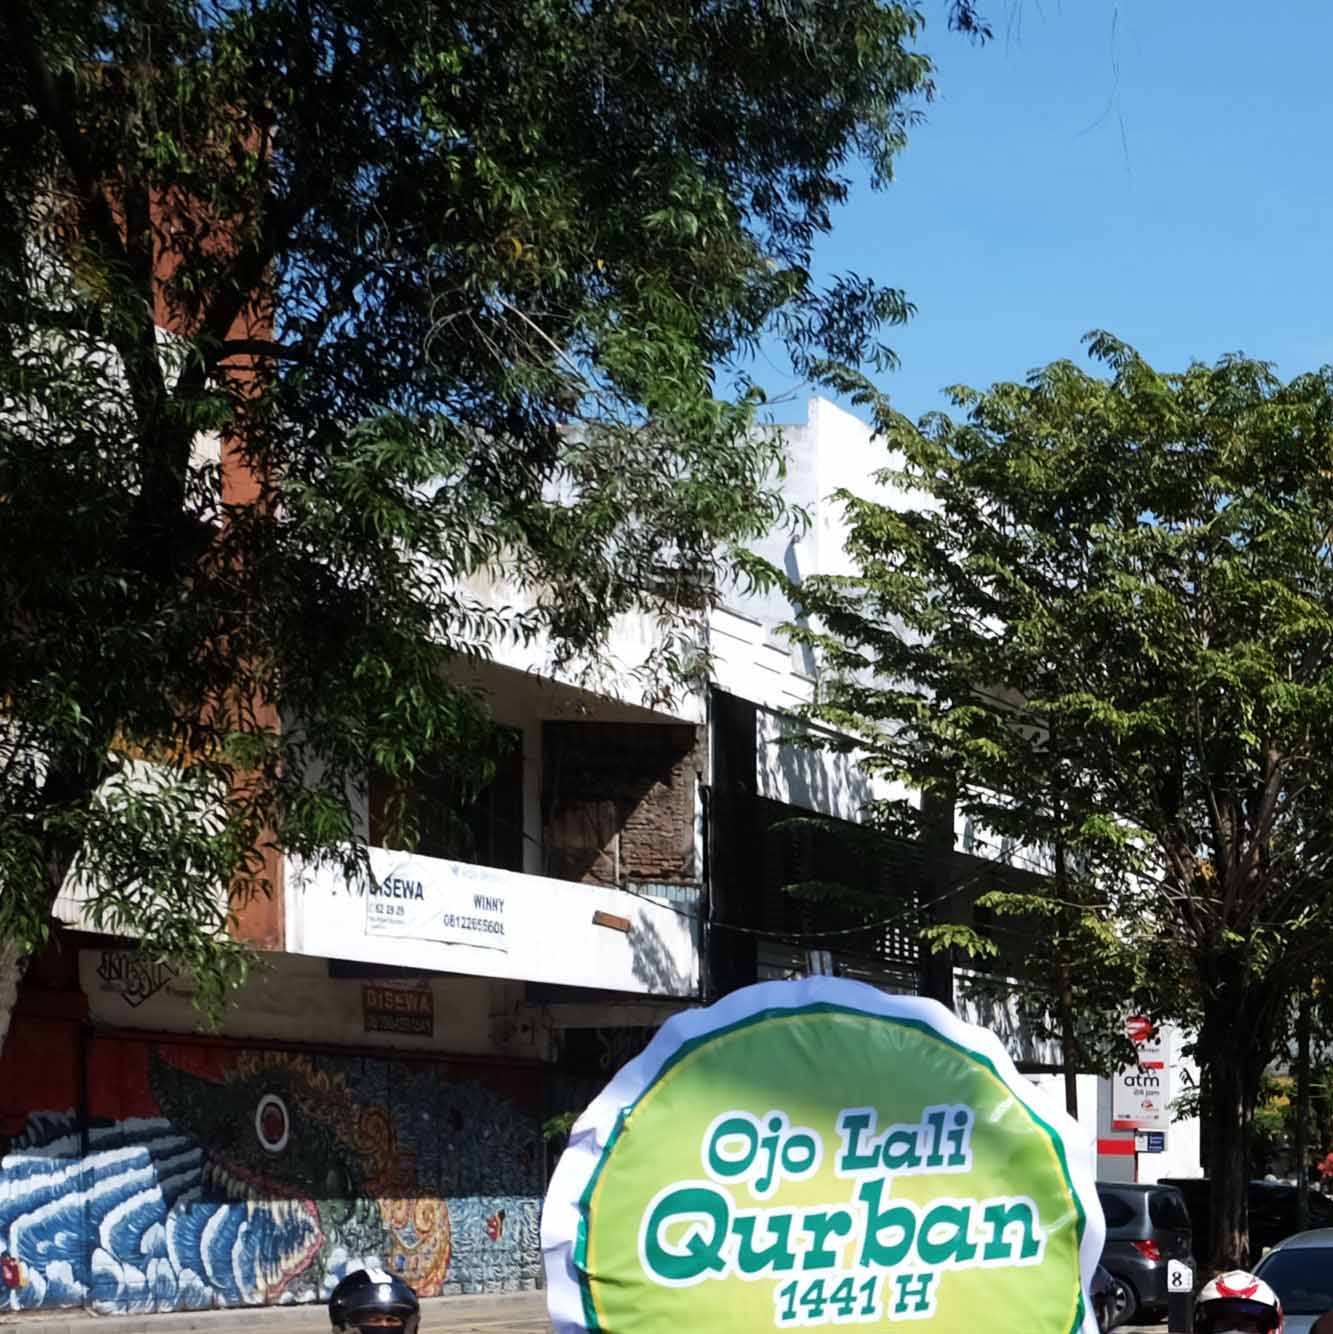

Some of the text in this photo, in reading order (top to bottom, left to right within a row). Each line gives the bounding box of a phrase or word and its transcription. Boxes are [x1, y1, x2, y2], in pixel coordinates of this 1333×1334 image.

[473, 894, 505, 914] WINNY
[1124, 1074, 1160, 1087] atm
[708, 1110, 969, 1193] Ojo Lali
[643, 1179, 1040, 1280] Qurban
[1172, 1271, 1183, 1287] 8
[781, 1273, 933, 1320] 1441 H
